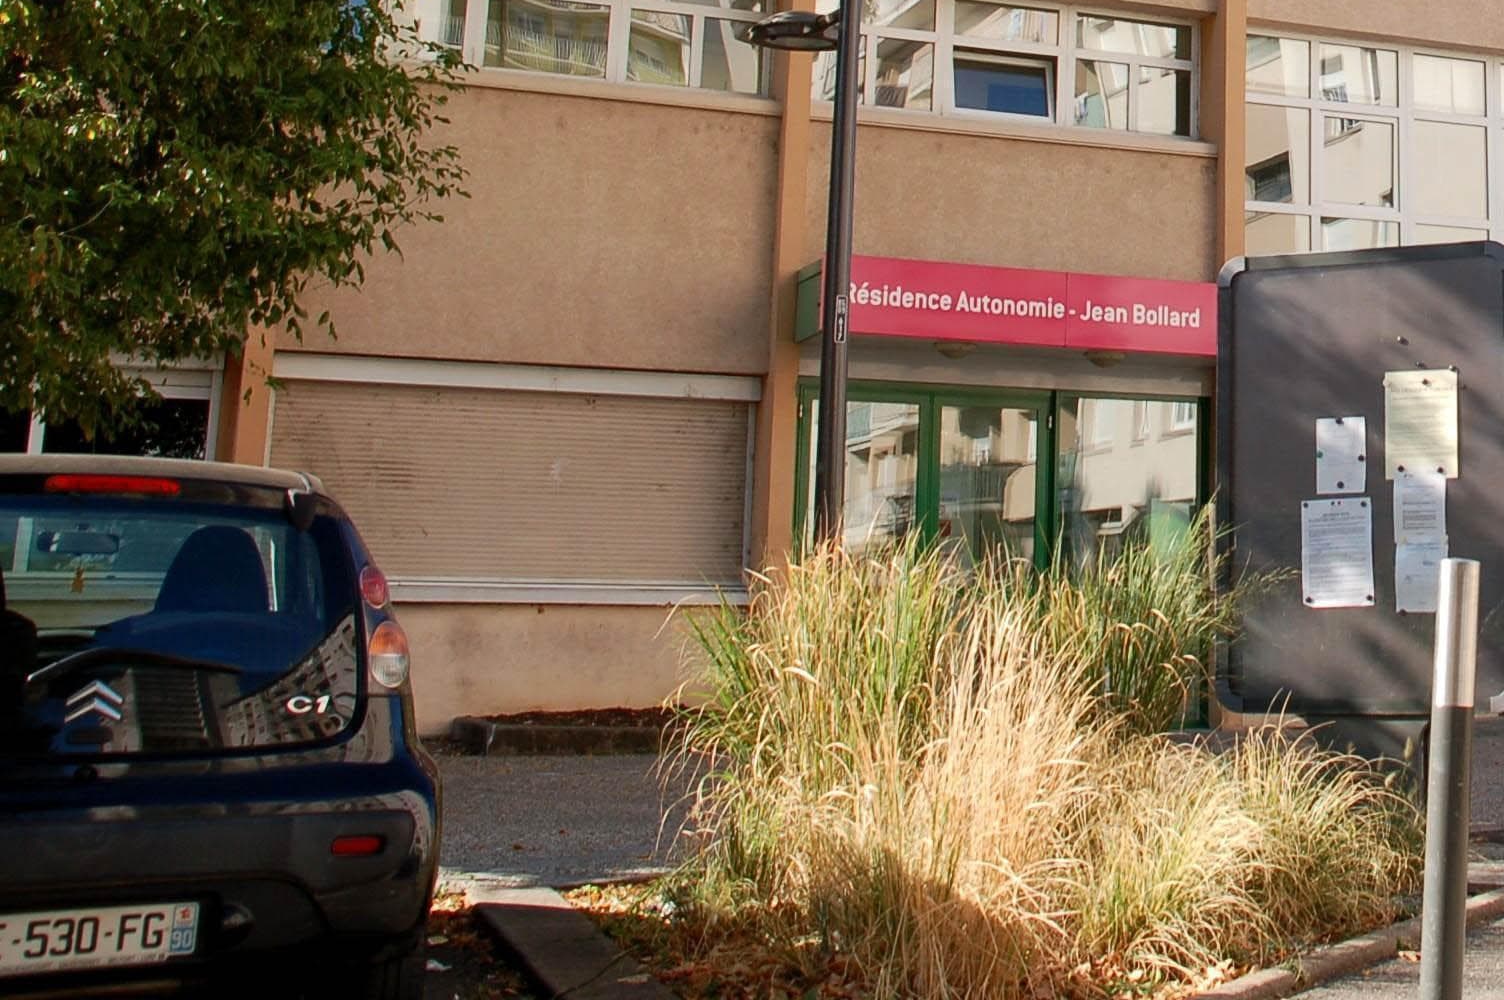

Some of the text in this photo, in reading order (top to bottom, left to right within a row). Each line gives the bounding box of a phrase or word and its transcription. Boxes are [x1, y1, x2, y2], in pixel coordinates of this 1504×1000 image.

[956, 290, 1065, 319] Autonomie
[1080, 300, 1128, 323] Jean
[1133, 303, 1200, 328] Bollard
[287, 695, 330, 714] C1
[0, 912, 165, 960] -530-FG
[171, 930, 193, 951] 90
